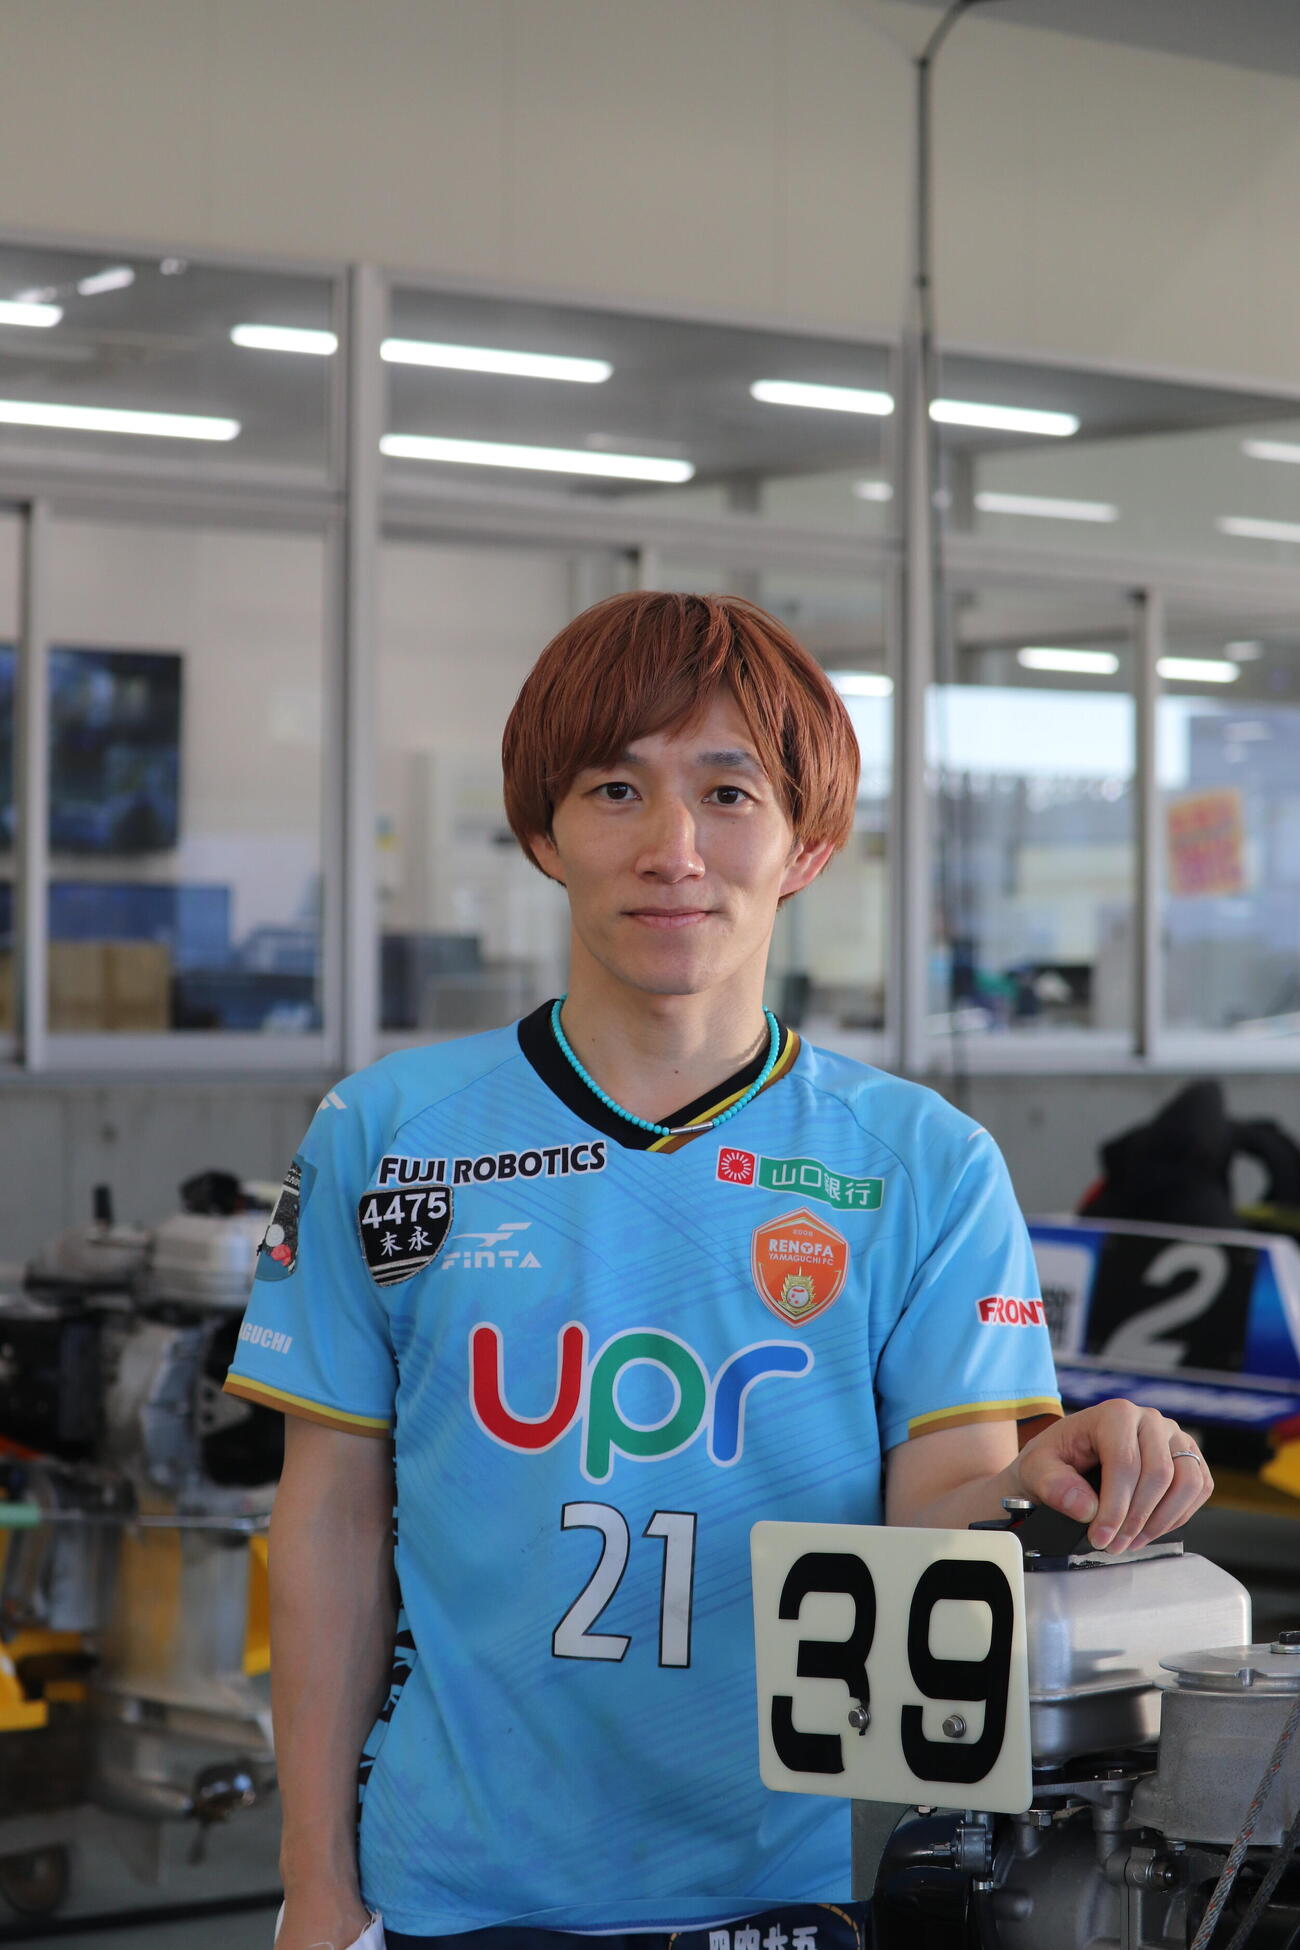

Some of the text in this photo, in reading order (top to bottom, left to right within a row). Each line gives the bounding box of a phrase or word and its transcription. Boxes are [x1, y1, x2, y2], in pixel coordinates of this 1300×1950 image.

[378, 1141, 606, 1184] FUJI ROBOTICS
[771, 1163, 872, 1206] 山口銀行
[361, 1191, 448, 1229] 4475
[379, 1225, 434, 1257] 末永
[768, 1238, 835, 1258] RENOFA
[768, 1252, 835, 1267] YAMAGUCHI FC
[1103, 1241, 1229, 1371] 2
[470, 1321, 814, 1484] upr
[552, 1500, 698, 1669] 21
[771, 1551, 1014, 1784] 39
